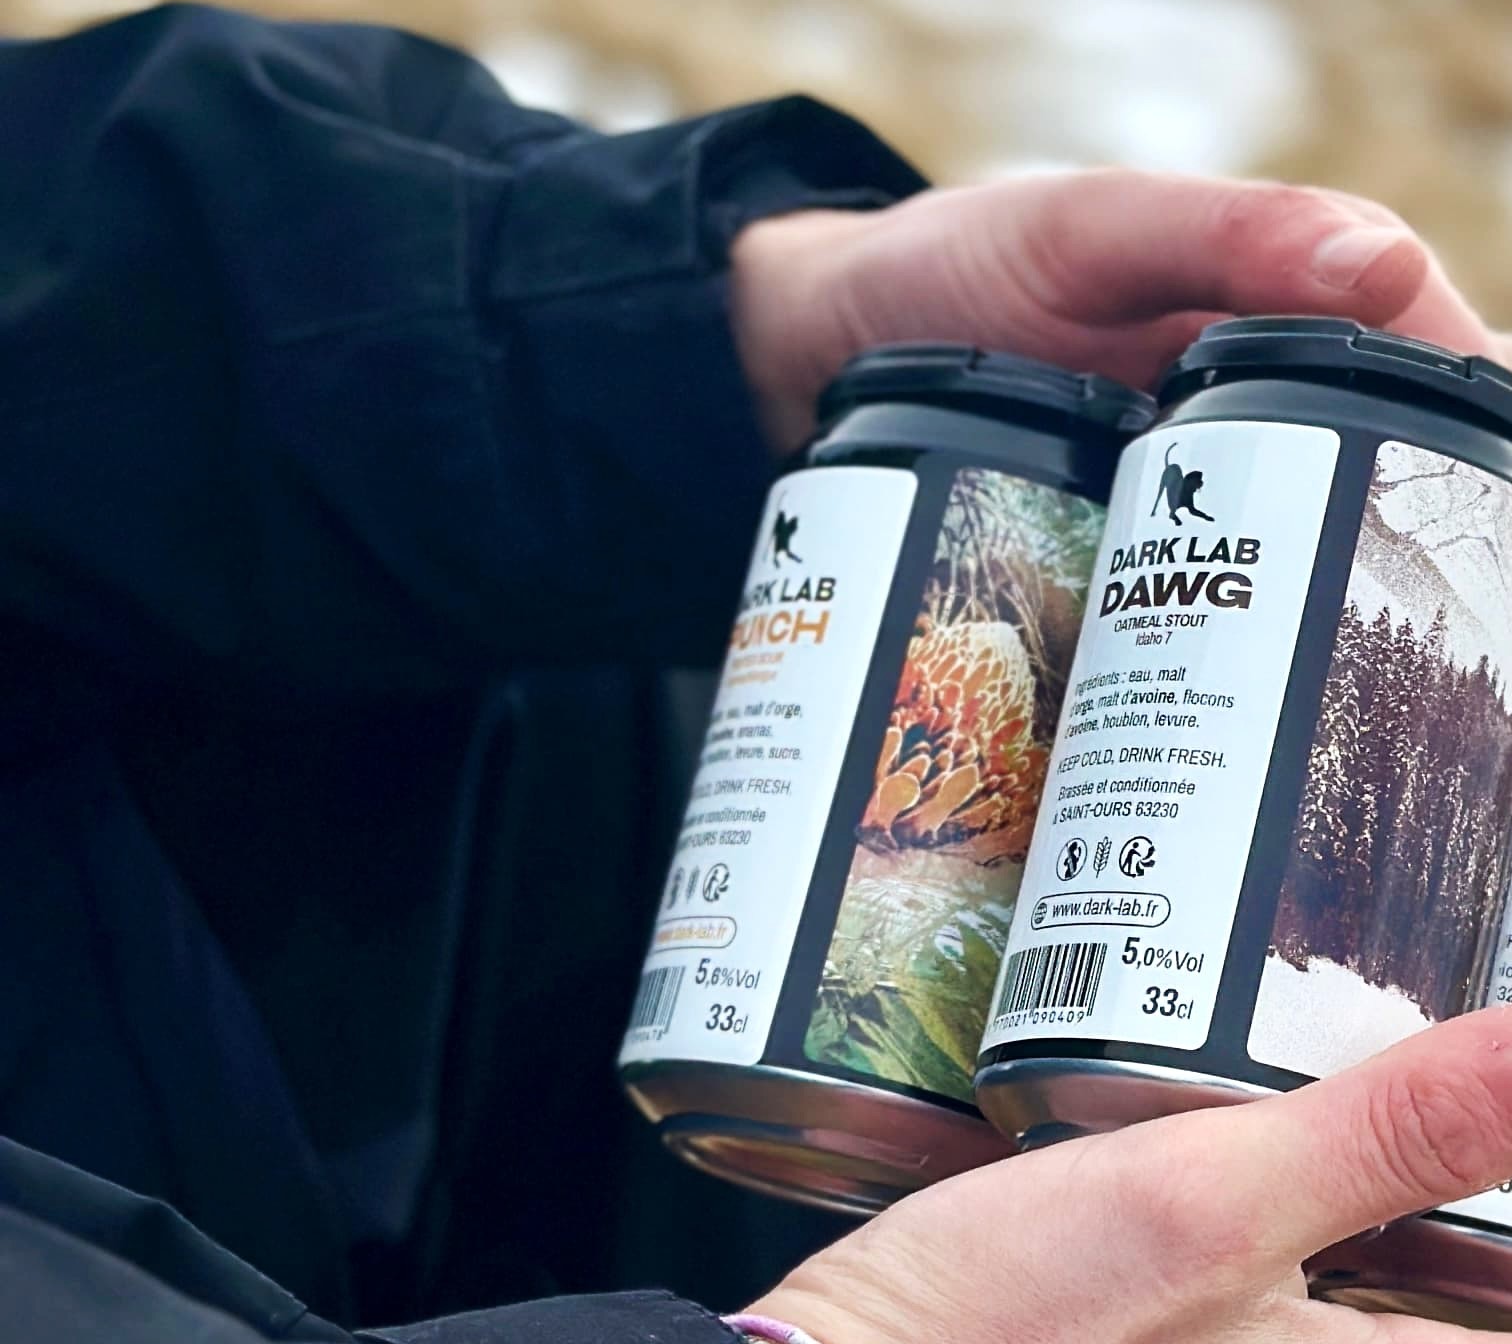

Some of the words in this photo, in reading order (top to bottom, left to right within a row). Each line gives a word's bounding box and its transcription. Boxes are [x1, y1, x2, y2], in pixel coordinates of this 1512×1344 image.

[1109, 537, 1182, 576] DARK
[1186, 536, 1261, 565] LAB
[779, 576, 837, 603] LAB
[1099, 571, 1254, 618] DAWG
[1114, 615, 1162, 633] OATMEAL
[1165, 613, 1208, 629] STOUT
[1135, 632, 1163, 647] Idaho
[1164, 631, 1173, 645] 7
[1128, 668, 1153, 683] eau,
[1157, 665, 1187, 682] malt
[1097, 691, 1120, 709] malt
[1121, 688, 1179, 706] d'avoine,
[1182, 689, 1235, 709] flocons
[1102, 711, 1151, 729] houblon,
[1154, 710, 1201, 729] levure.
[1080, 748, 1115, 767] COLD,
[1119, 747, 1165, 764] DRINK
[1167, 747, 1228, 769] FRESH.
[713, 779, 745, 797] DRINK
[1057, 781, 1094, 802] Brassée
[1096, 779, 1108, 795] et
[1109, 777, 1196, 796] conditionnée
[1059, 801, 1133, 824] SAINT-OURS
[1135, 801, 1179, 819] 63230
[719, 830, 752, 846] 63230
[1051, 897, 1159, 919] www.dark-lab.fr
[1142, 985, 1194, 1020] 33cl
[704, 1003, 748, 1034] 33cl
